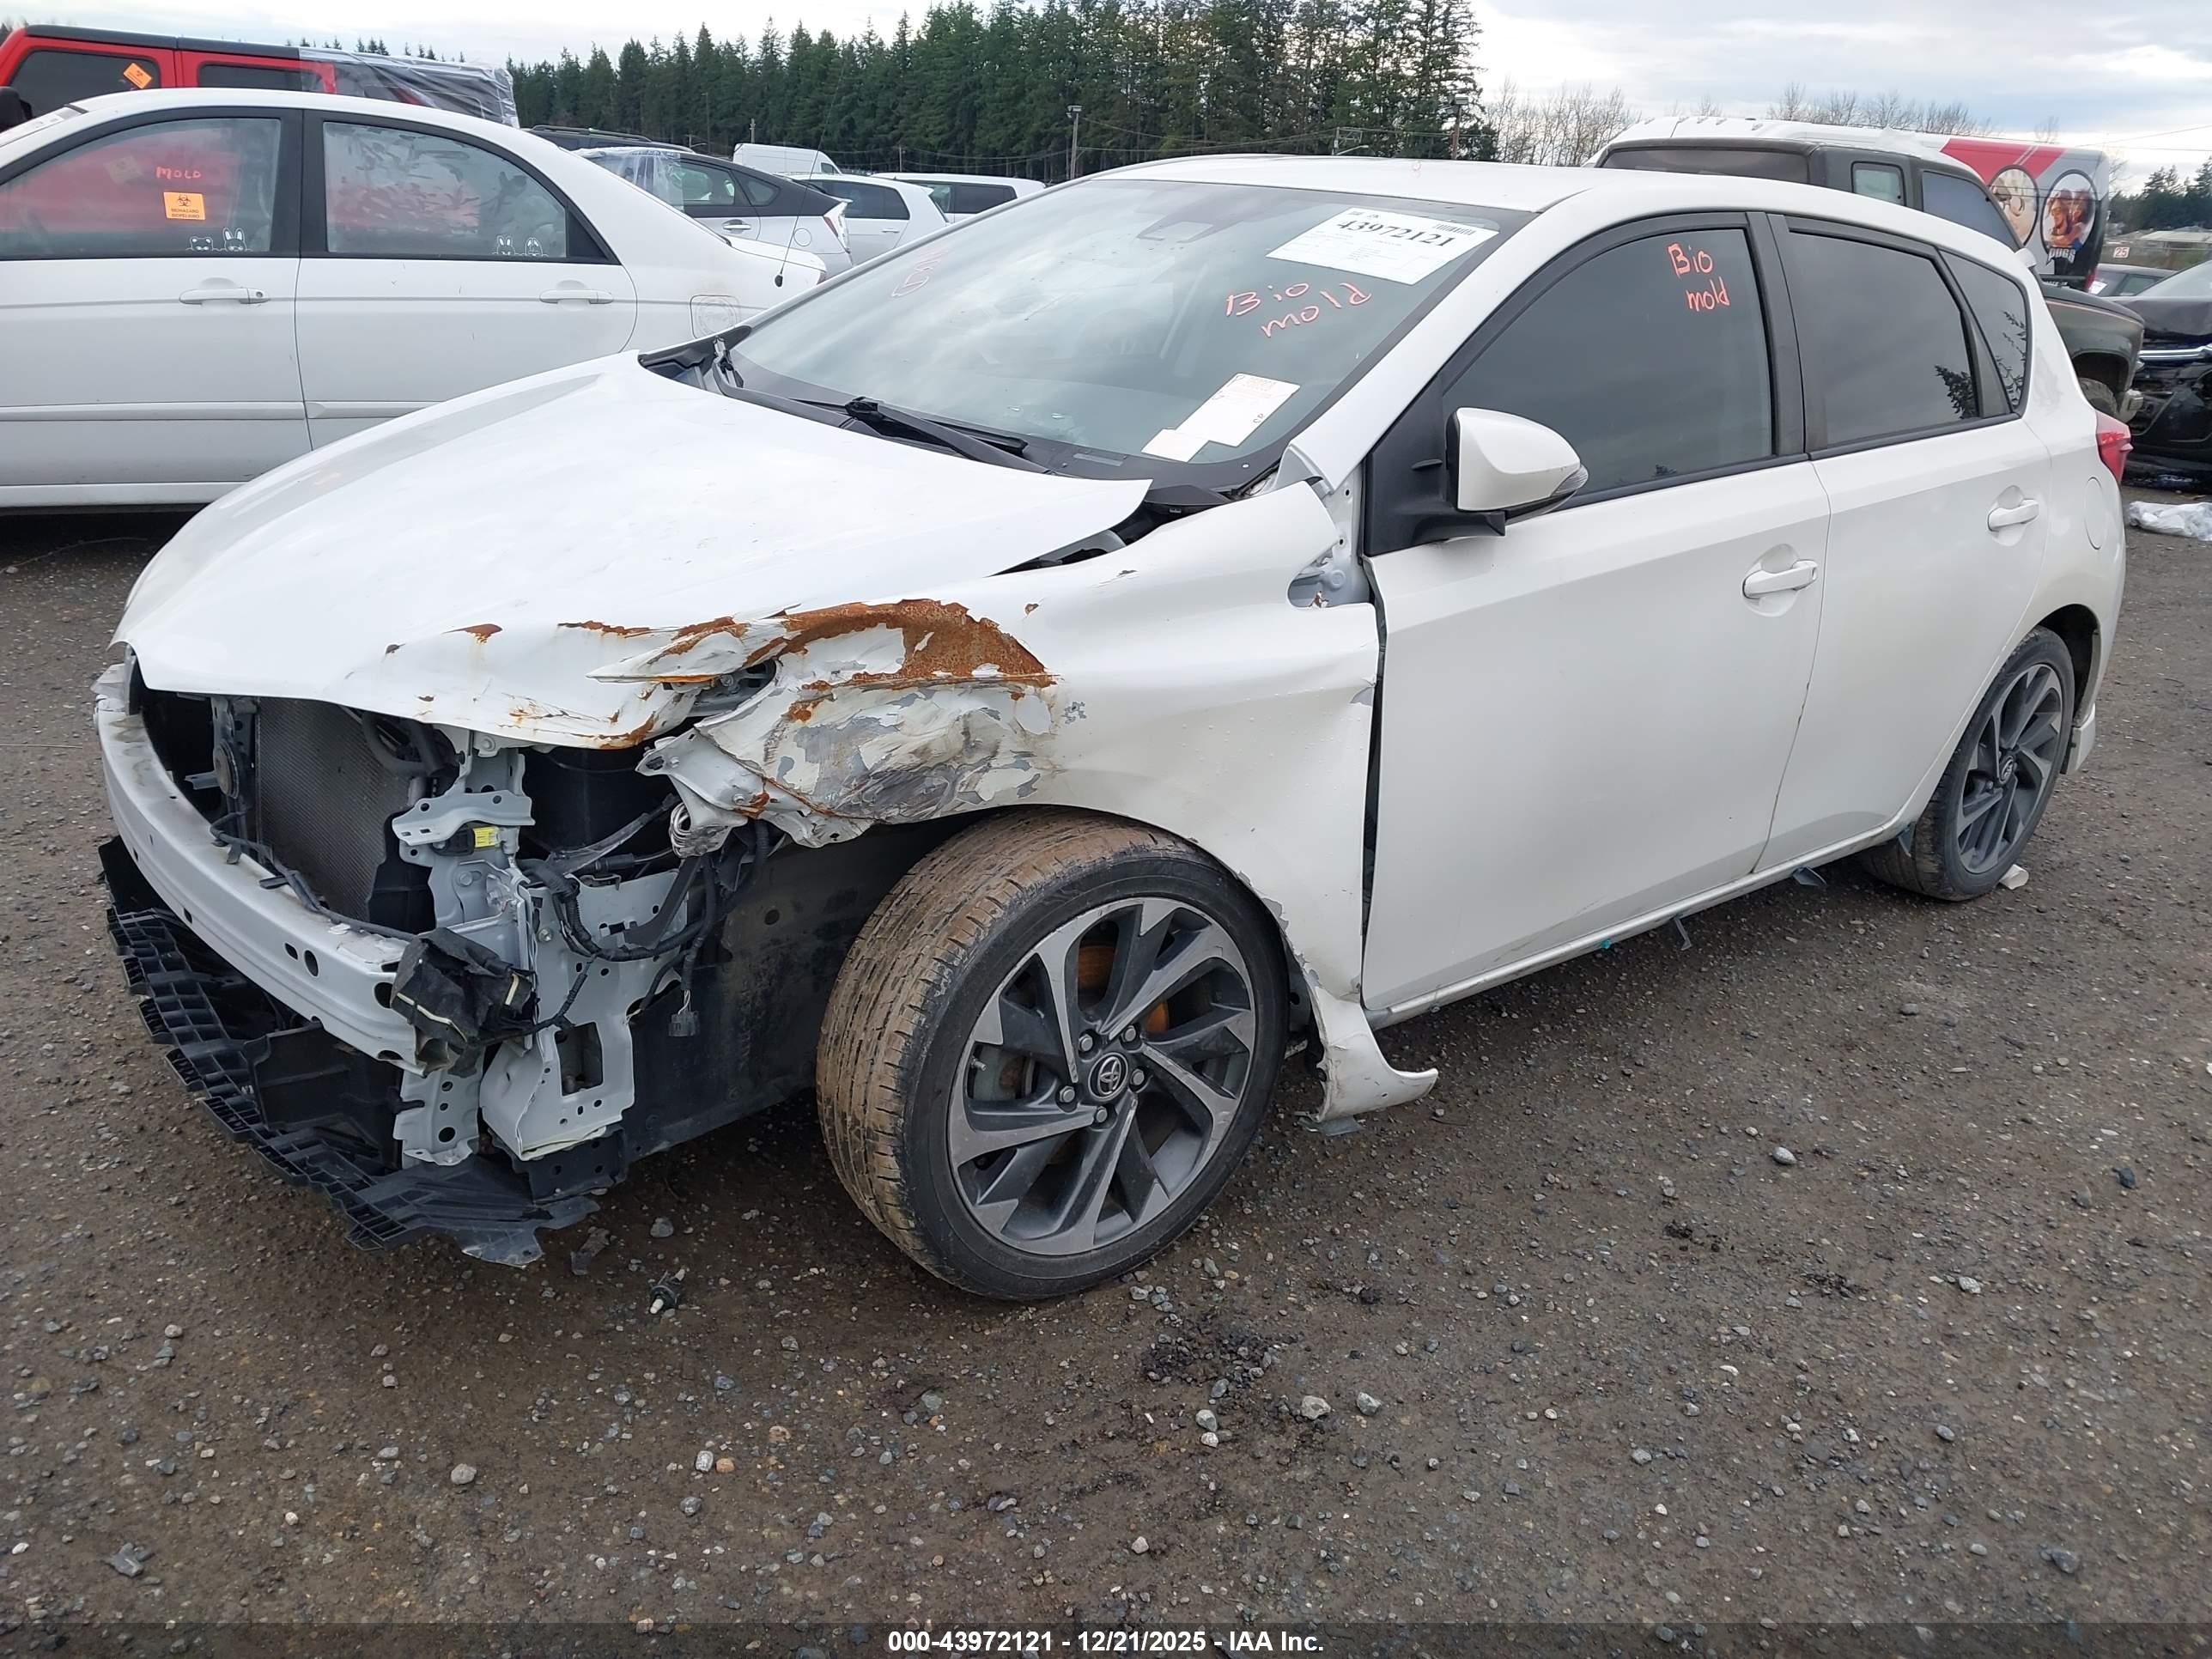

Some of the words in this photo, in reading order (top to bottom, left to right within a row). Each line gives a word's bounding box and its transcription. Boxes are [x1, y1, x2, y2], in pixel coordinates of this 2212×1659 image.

[1337, 220, 1455, 246] 43972121
[1668, 244, 1714, 276] Bio
[2115, 247, 2128, 258] 25
[1225, 282, 1310, 317] Bio
[1261, 283, 1372, 337] mold
[1686, 278, 1731, 312] mold
